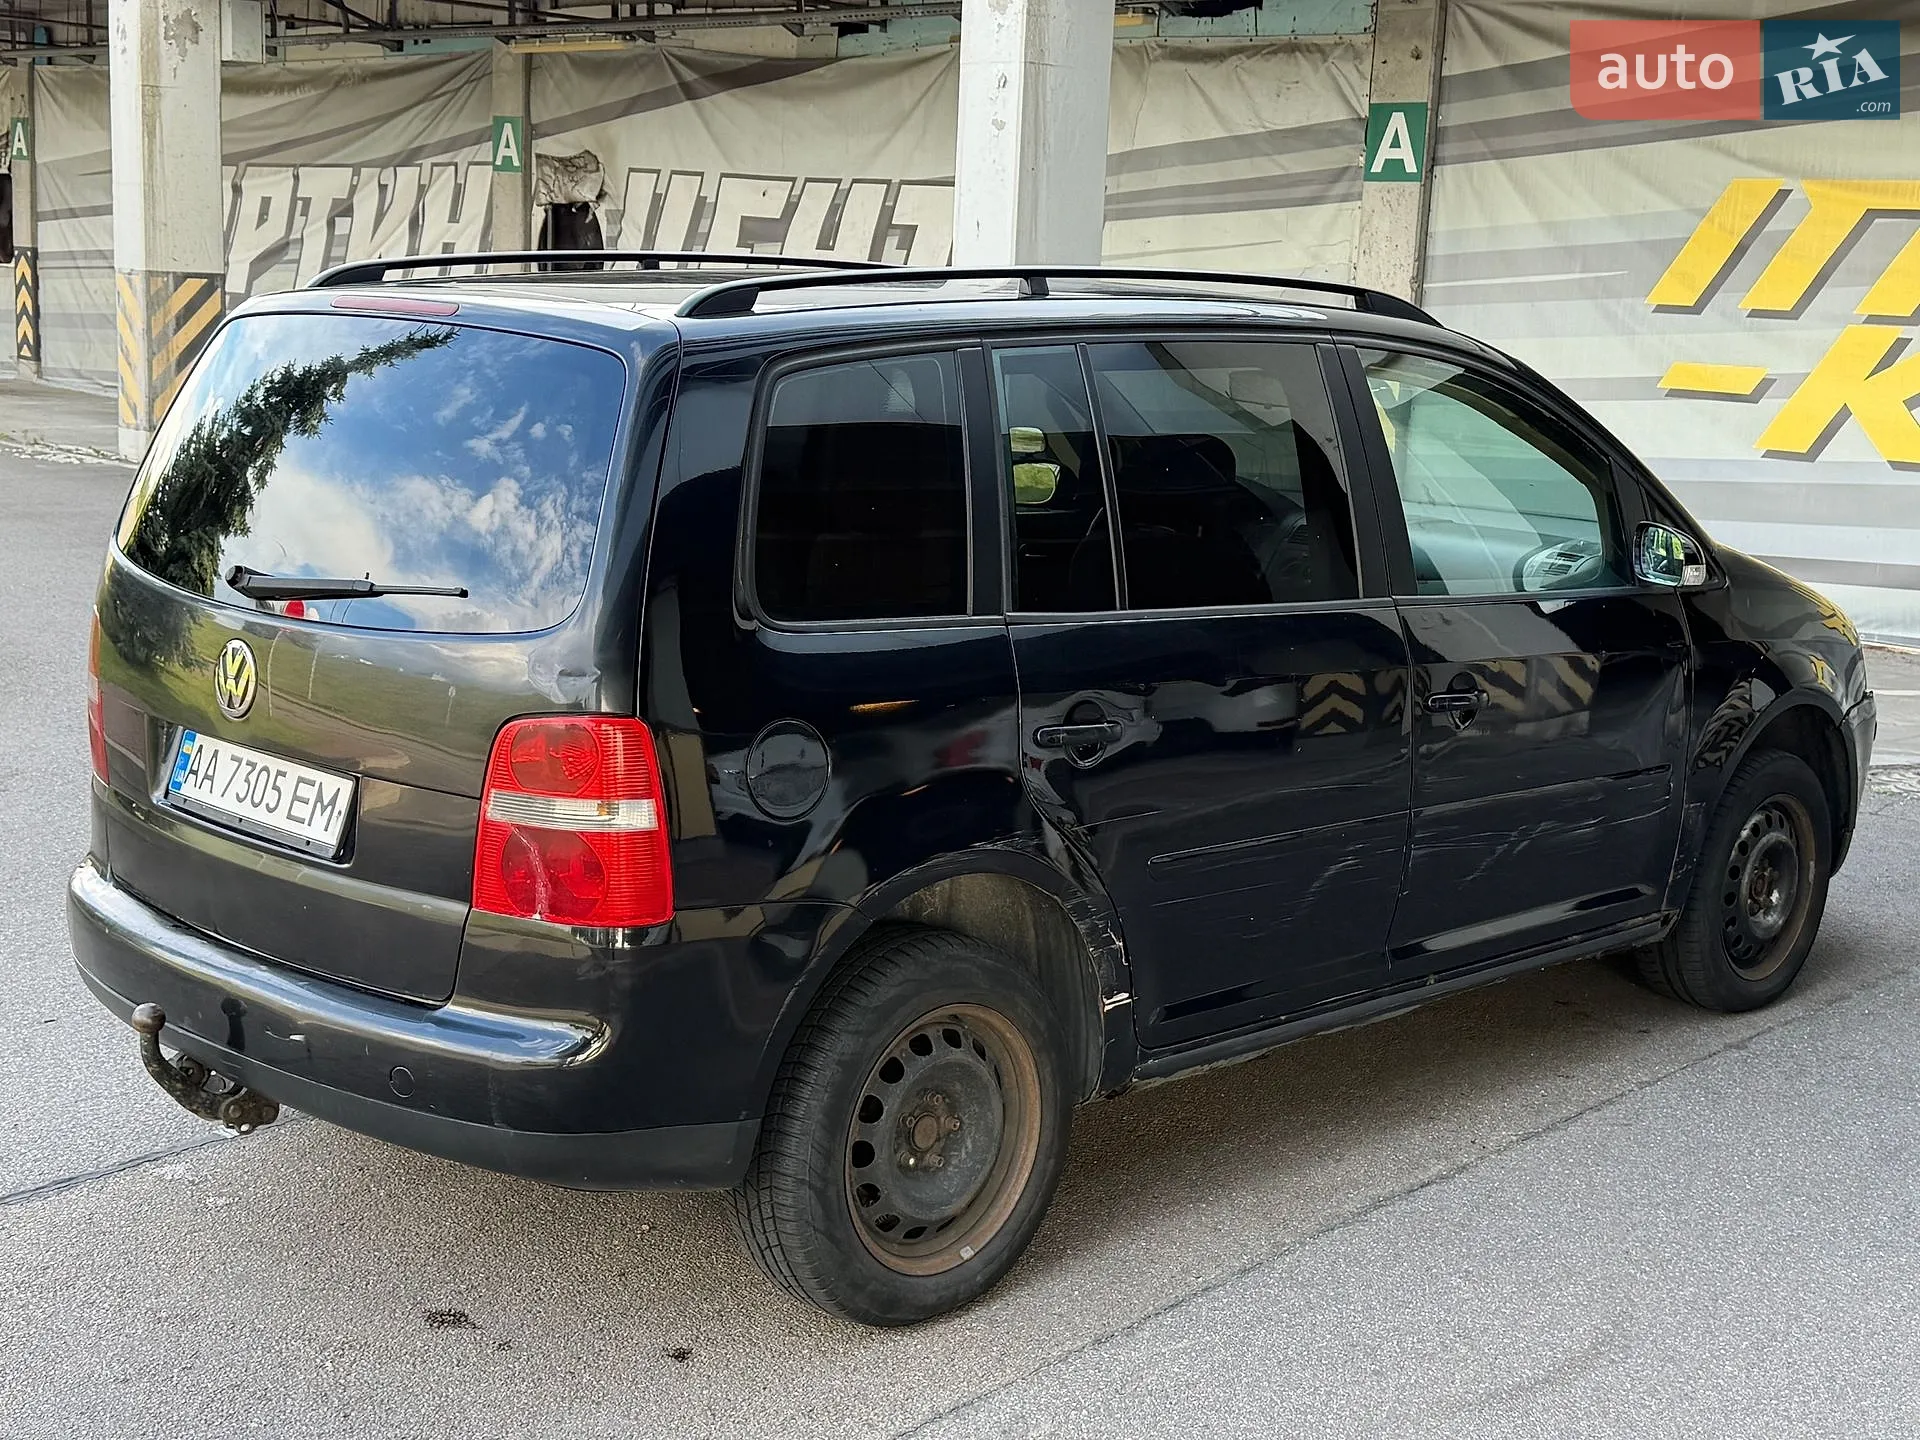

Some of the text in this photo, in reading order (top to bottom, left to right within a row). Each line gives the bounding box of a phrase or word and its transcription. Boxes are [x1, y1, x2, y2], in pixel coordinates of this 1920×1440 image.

[12, 121, 28, 157] A
[495, 122, 520, 167] A
[1370, 111, 1418, 173] A
[223, 164, 493, 293] РТИН
[184, 744, 341, 832] AA 7305 EM
